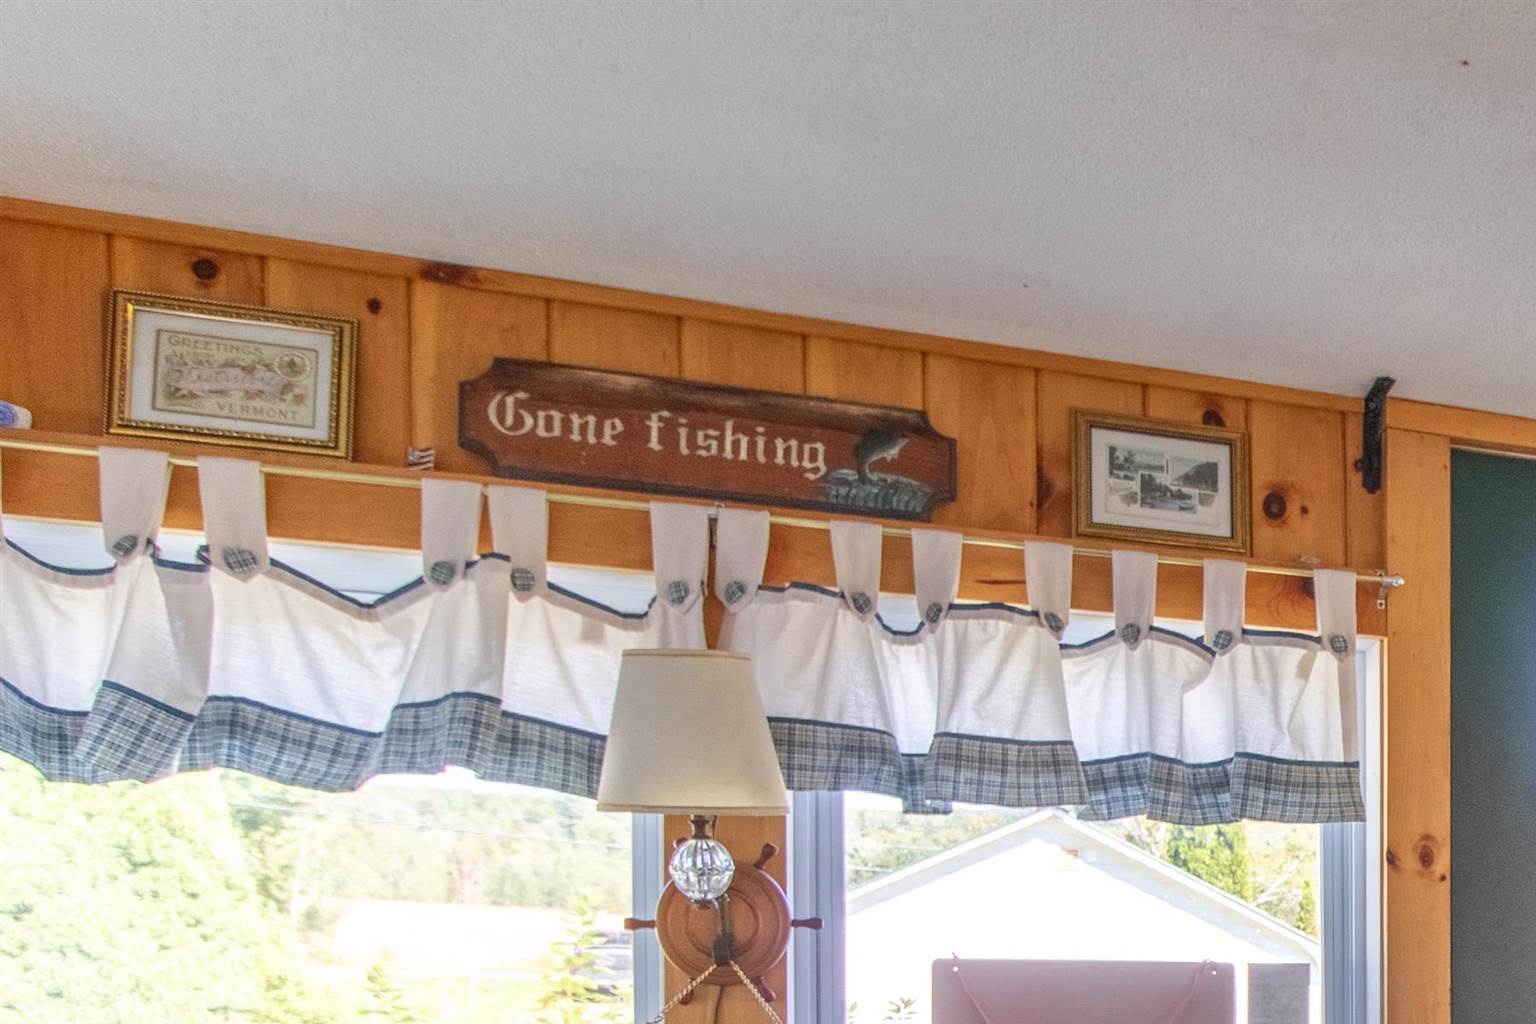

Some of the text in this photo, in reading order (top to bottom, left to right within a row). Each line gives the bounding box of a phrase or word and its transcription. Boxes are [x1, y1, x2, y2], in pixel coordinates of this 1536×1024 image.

[168, 335, 264, 356] GREETINGS
[216, 401, 299, 420] VERMONT
[486, 389, 829, 482] Gone fishing
